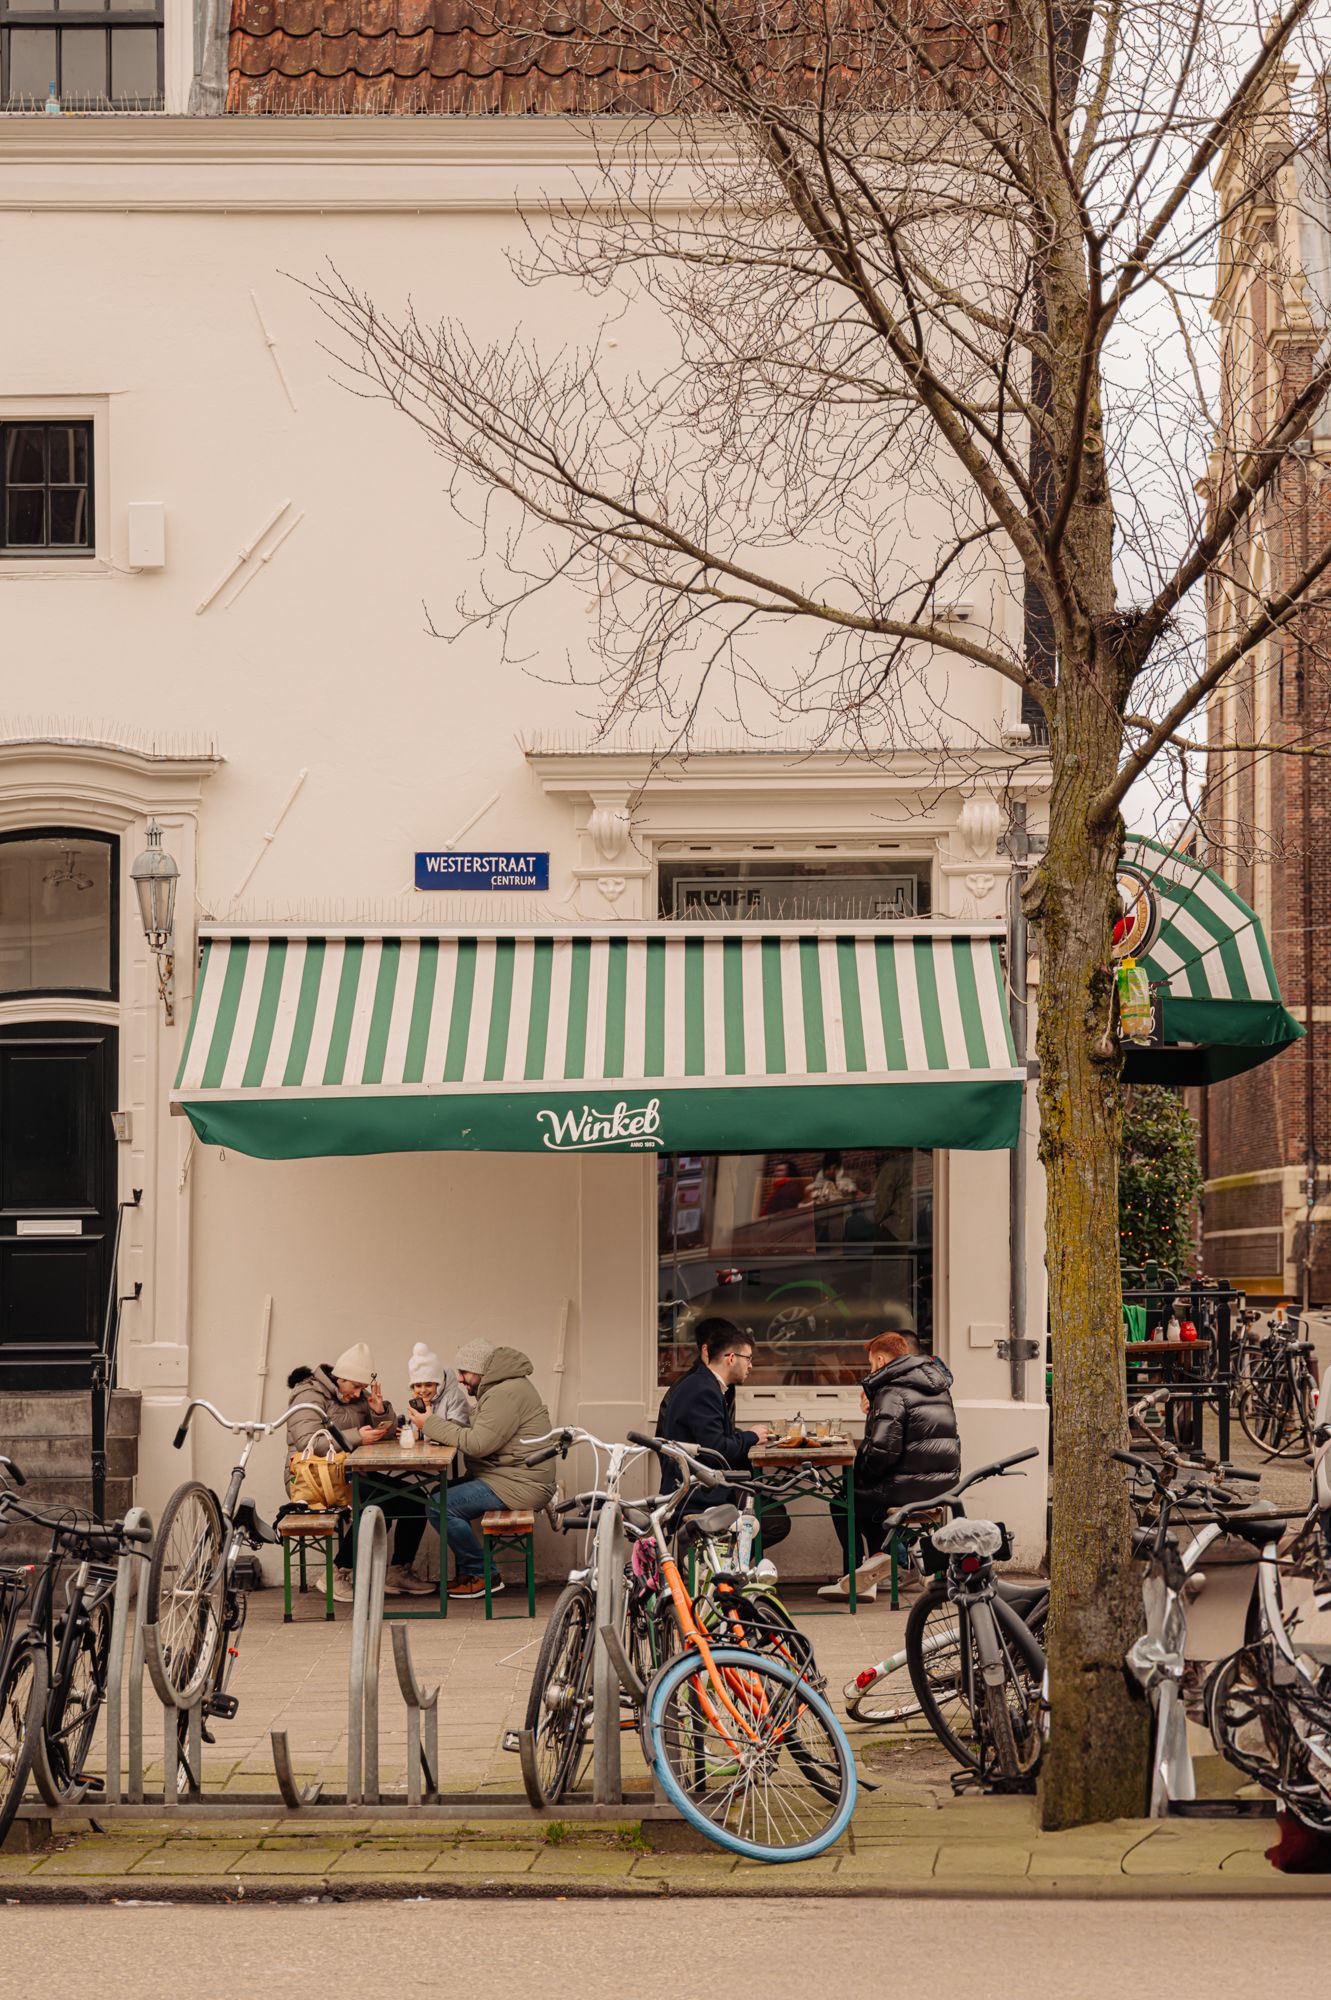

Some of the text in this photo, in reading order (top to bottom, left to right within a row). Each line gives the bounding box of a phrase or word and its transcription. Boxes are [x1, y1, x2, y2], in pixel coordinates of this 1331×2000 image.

[425, 856, 537, 873] WESTERSTRAAT
[491, 875, 537, 886] CENTRUM
[537, 1098, 660, 1145] Winkel
